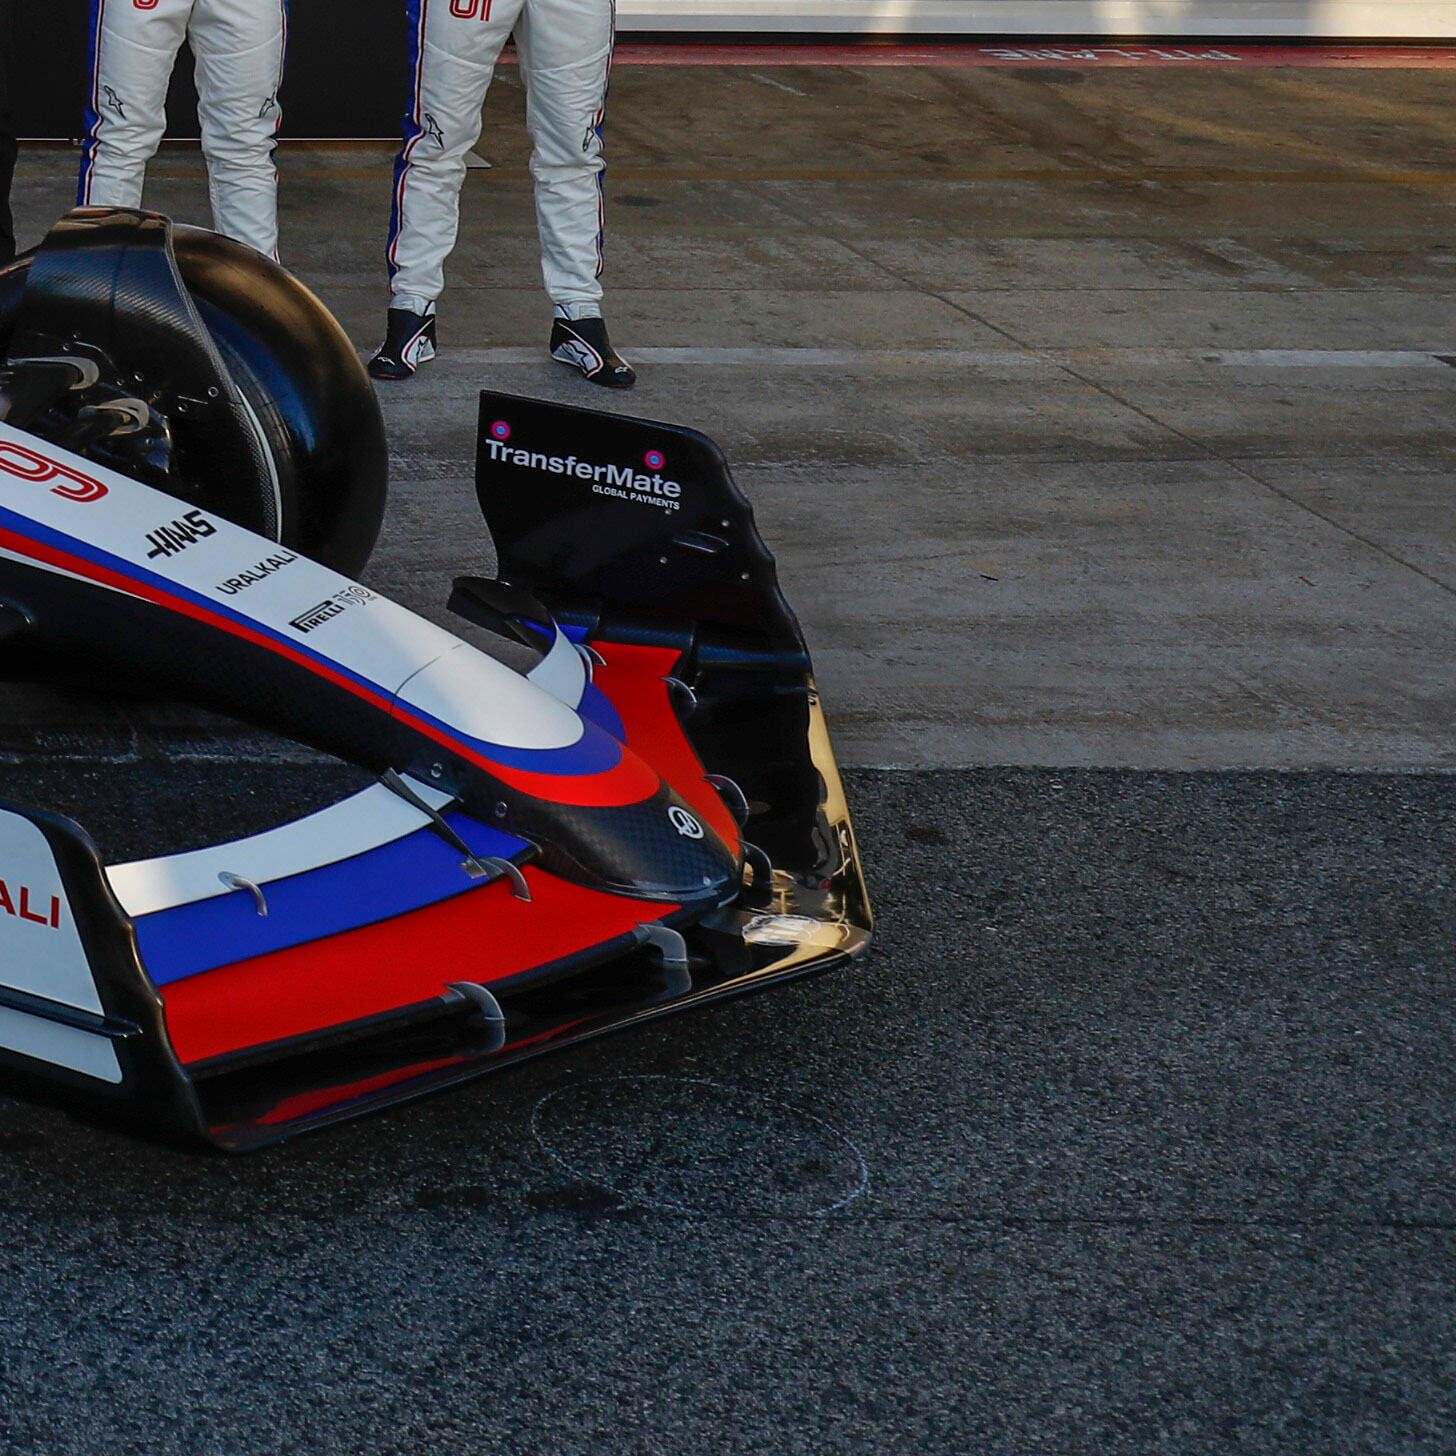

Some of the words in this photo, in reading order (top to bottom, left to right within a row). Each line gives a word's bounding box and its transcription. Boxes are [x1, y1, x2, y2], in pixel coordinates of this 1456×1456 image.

[485, 439, 682, 498] TransferMate
[592, 484, 628, 500] GLOBAL
[630, 492, 680, 510] PAYMENTS
[147, 510, 217, 559] HAAS
[216, 550, 298, 595] URALKALI
[288, 600, 345, 633] PIRELLI
